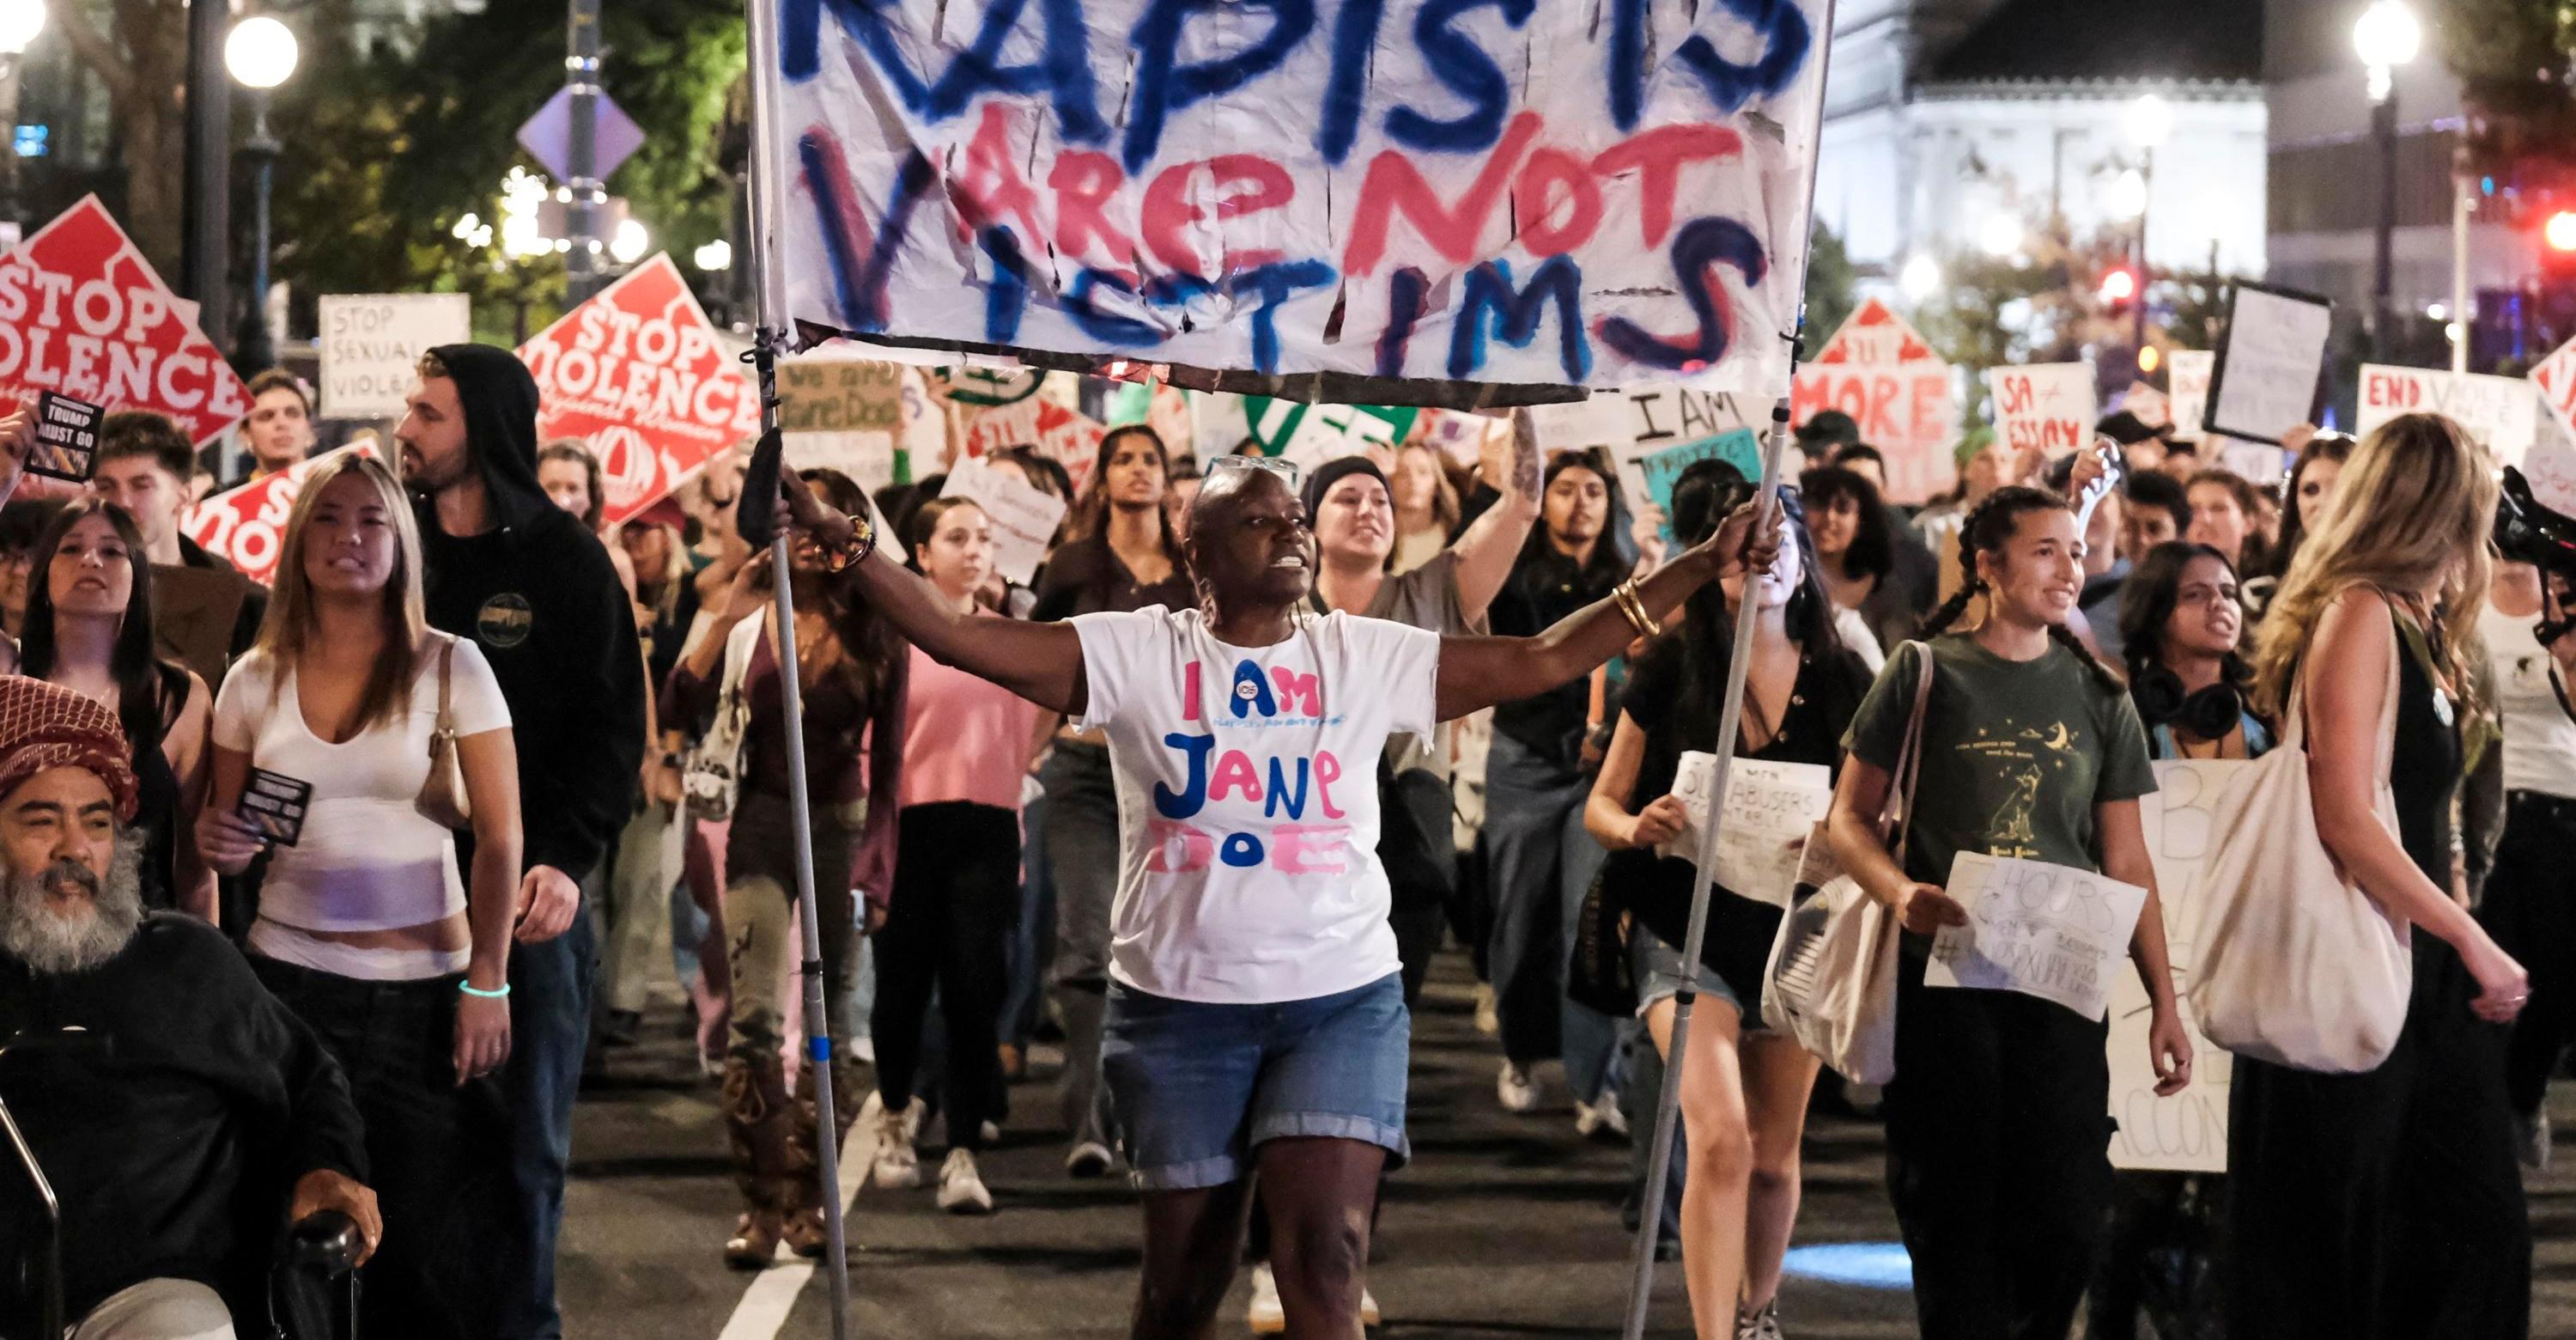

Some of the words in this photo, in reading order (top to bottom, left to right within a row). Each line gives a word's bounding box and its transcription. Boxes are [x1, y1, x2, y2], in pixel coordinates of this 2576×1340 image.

[1342, 108, 1745, 280] NOT
[0, 263, 169, 344] STOP
[334, 305, 394, 333] STOP
[332, 338, 422, 364] SEXUAL
[574, 301, 711, 371] STOP
[1630, 393, 1674, 442] I
[1680, 387, 1745, 436] AM
[1789, 374, 1947, 443] MORE
[2002, 375, 2034, 414] SA
[2366, 372, 2421, 410] END
[38, 423, 72, 444] MUST
[76, 432, 94, 449] GO
[47, 404, 91, 428] TRUMP
[2008, 417, 2081, 450] ESSAY
[1182, 661, 1201, 721] I
[1229, 658, 1321, 719] AM
[1145, 818, 1352, 876] DOE
